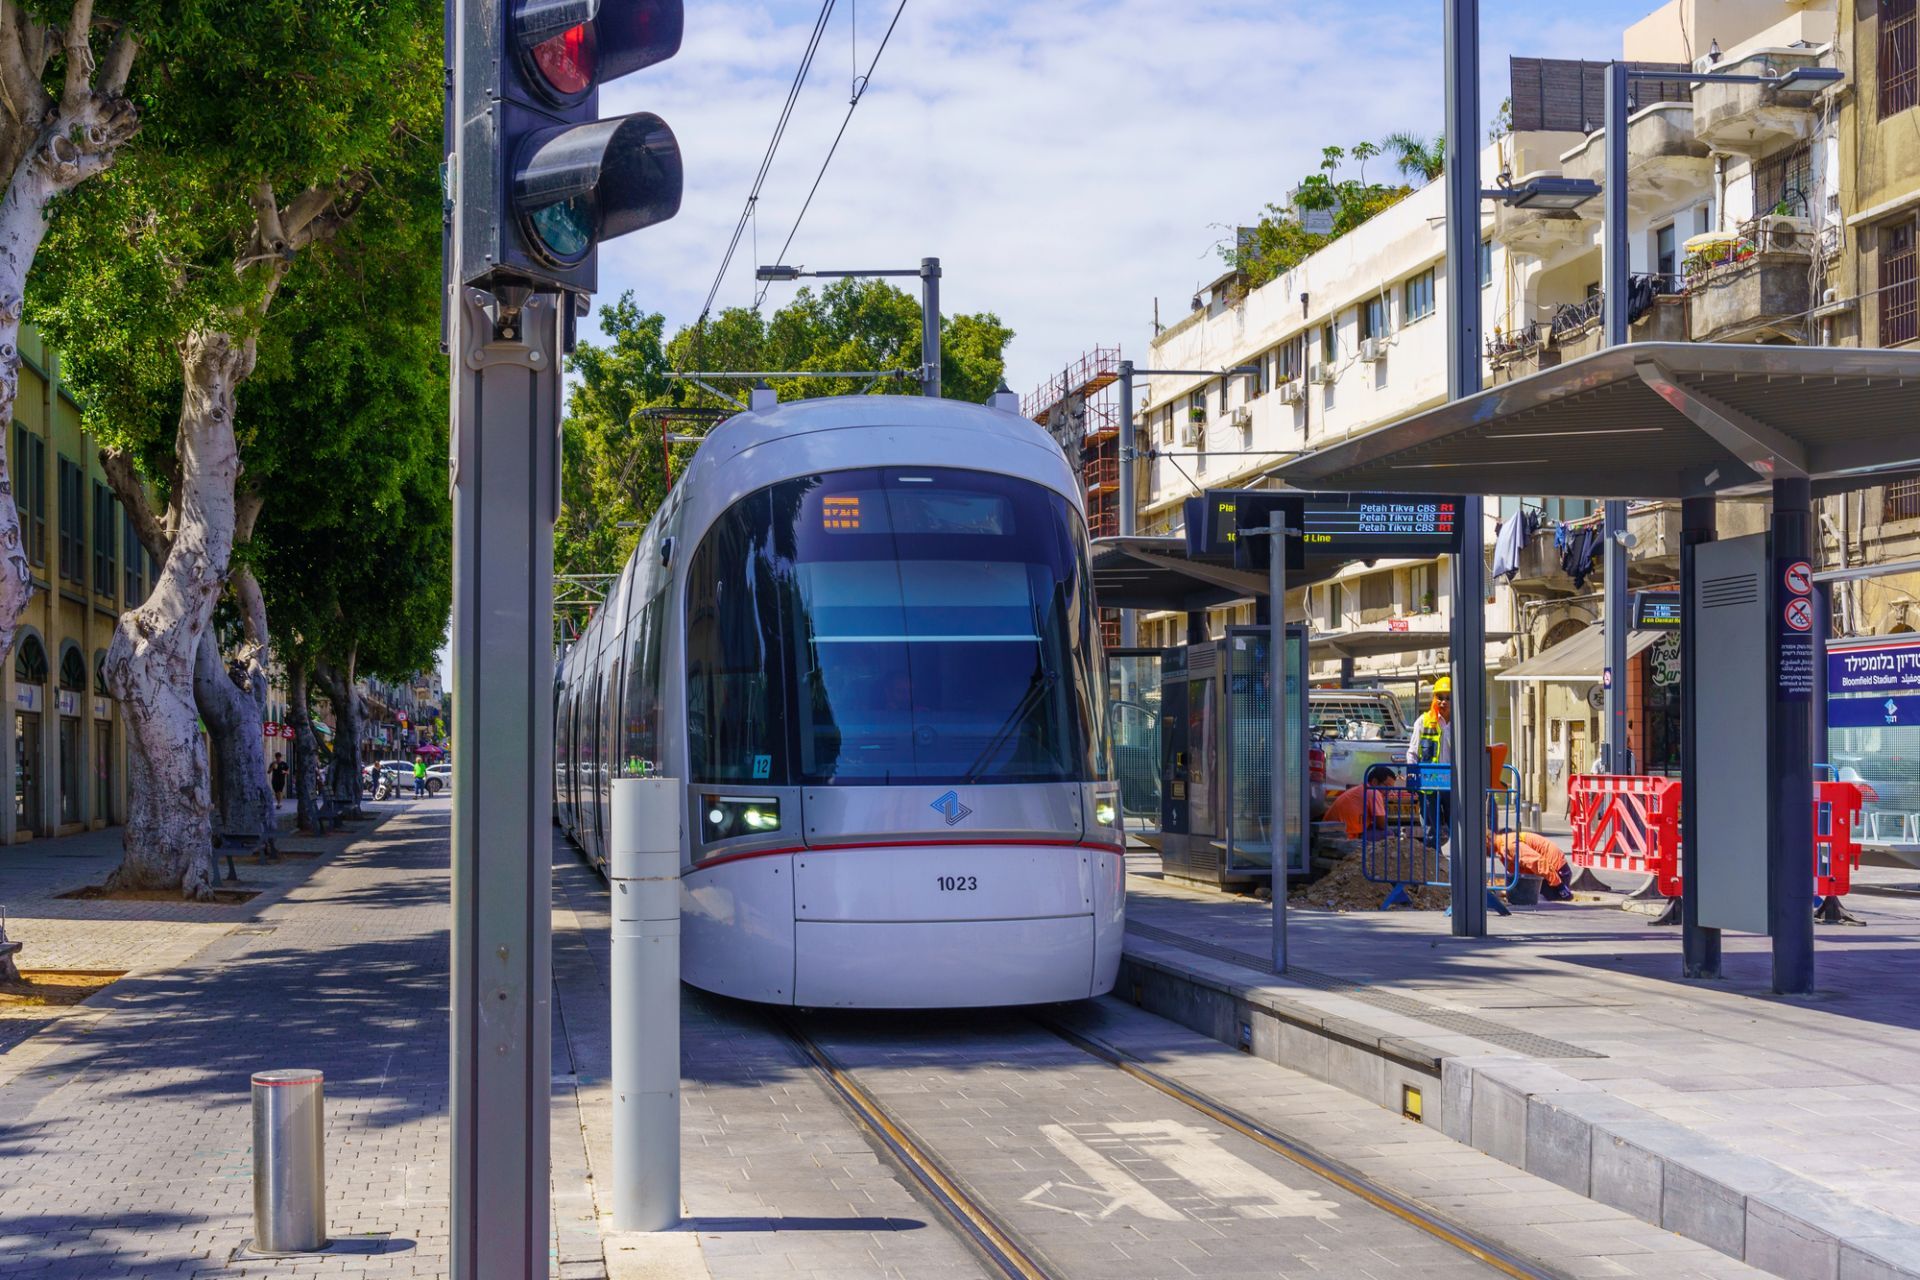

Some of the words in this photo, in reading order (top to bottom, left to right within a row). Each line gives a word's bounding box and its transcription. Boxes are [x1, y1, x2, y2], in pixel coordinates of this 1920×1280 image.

[1360, 504, 1387, 512] Petah
[1389, 504, 1414, 512] Tikva
[1417, 504, 1436, 512] CBS
[1440, 503, 1453, 512] R1
[1360, 514, 1386, 522] Petah
[1389, 514, 1413, 522] Tikva
[1416, 514, 1435, 522] CBS
[1359, 523, 1386, 532] Petah
[1388, 523, 1412, 532] Tikva
[1415, 523, 1434, 532] CBS
[1311, 534, 1331, 542] Line
[1844, 653, 1895, 672] בלומפילד
[1653, 662, 1681, 684] Bar
[1842, 676, 1873, 687] Bloomfield
[1873, 675, 1898, 685] Stadium
[756, 759, 769, 774] 12
[937, 876, 977, 891] 1023
